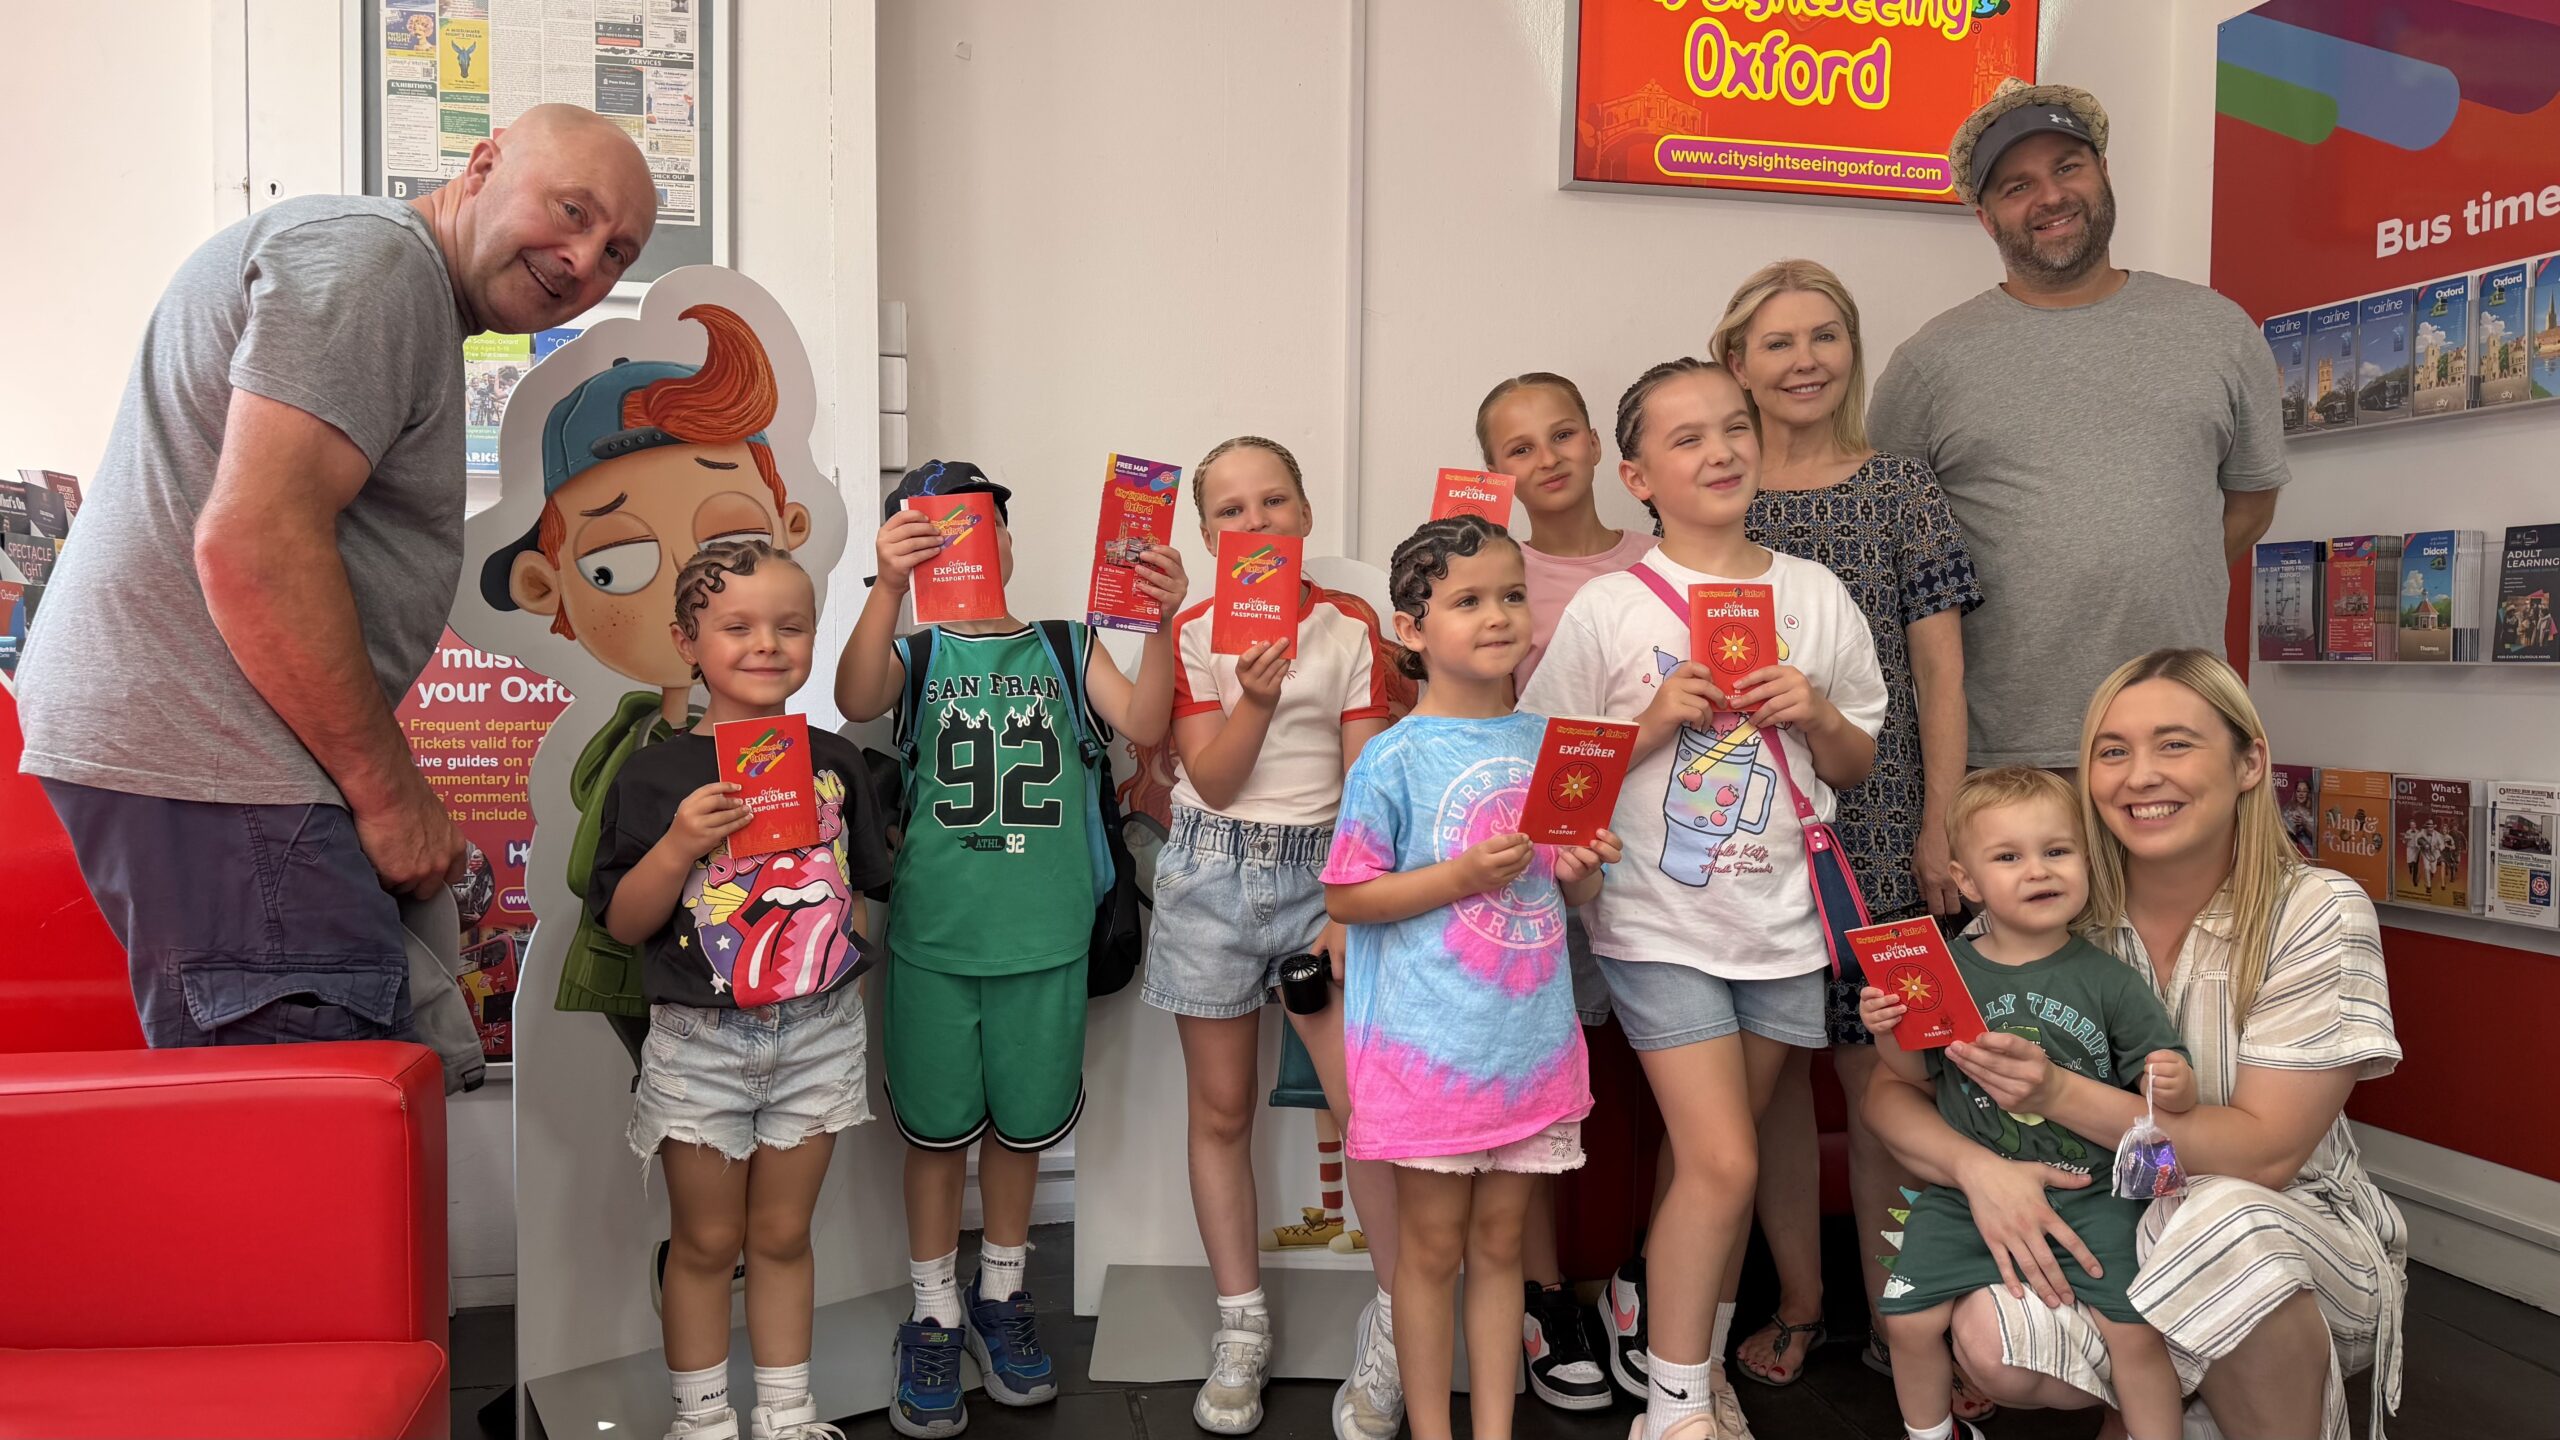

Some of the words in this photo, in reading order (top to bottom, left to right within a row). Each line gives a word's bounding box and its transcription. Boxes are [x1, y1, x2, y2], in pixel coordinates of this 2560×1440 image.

[1685, 17, 1892, 110] Oxford
[391, 81, 433, 90] EXHIBITIONS
[1670, 146, 1943, 181] www.citysightseeingoxford.com
[2376, 214, 2452, 259] Bus
[2463, 184, 2560, 236] time
[2493, 273, 2523, 288] Oxford
[2435, 285, 2464, 299] Oxford
[2373, 297, 2403, 315] airline
[2322, 309, 2350, 325] airline
[2275, 319, 2301, 334] airline
[466, 452, 499, 463] ARKS
[1116, 461, 1133, 470] FREE
[1133, 465, 1149, 473] MAP
[1448, 490, 1498, 503] EXPLORER
[1124, 499, 1154, 515] Oxford
[8, 542, 52, 562] SPECTACLE
[2423, 547, 2448, 556] Didcot
[2507, 549, 2542, 559] ADULT
[2506, 557, 2560, 568] LEARNING
[933, 564, 983, 576] EXPLORER
[1233, 602, 1281, 613] EXPLORER
[1707, 608, 1760, 618] EXPLORER
[1724, 601, 1744, 613] Oxford
[1231, 611, 1262, 619] PASSPORT
[418, 681, 491, 709] your
[501, 676, 577, 703] Oxfo
[926, 675, 981, 704] SAN
[989, 672, 1061, 701] FRAN
[410, 719, 480, 734] Frequent
[485, 719, 553, 734] departur
[410, 736, 466, 750] Tickets
[471, 736, 507, 750] valid
[512, 736, 534, 750] for
[1579, 740, 1601, 752] Oxford
[1559, 745, 1616, 758] EXPLORER
[447, 755, 499, 770] guides
[503, 758, 522, 768] on
[933, 694, 1063, 828] 92
[2272, 778, 2289, 788] ORD
[2431, 783, 2463, 794] What's
[454, 791, 528, 803] comment
[745, 790, 797, 806] EXPLORER
[761, 786, 780, 799] Oxford
[2431, 793, 2446, 802] On
[751, 803, 780, 813] SSPORT
[781, 800, 801, 809] TRAIL
[1443, 770, 1495, 842] SURF
[472, 809, 527, 821] include
[2326, 811, 2361, 834] Map
[2363, 817, 2379, 834] &
[1005, 833, 1026, 853] 92
[2328, 836, 2377, 857] Guide
[1705, 843, 1738, 858] Hello
[1739, 843, 1769, 863] Kitty
[1699, 860, 1732, 874] And
[1733, 862, 1773, 877] Friends
[506, 895, 527, 904] ww
[1464, 901, 1565, 942] ARATH
[1872, 945, 1929, 962] EXPLORER
[1886, 942, 1907, 954] Oxford
[1985, 994, 2017, 1020] LY
